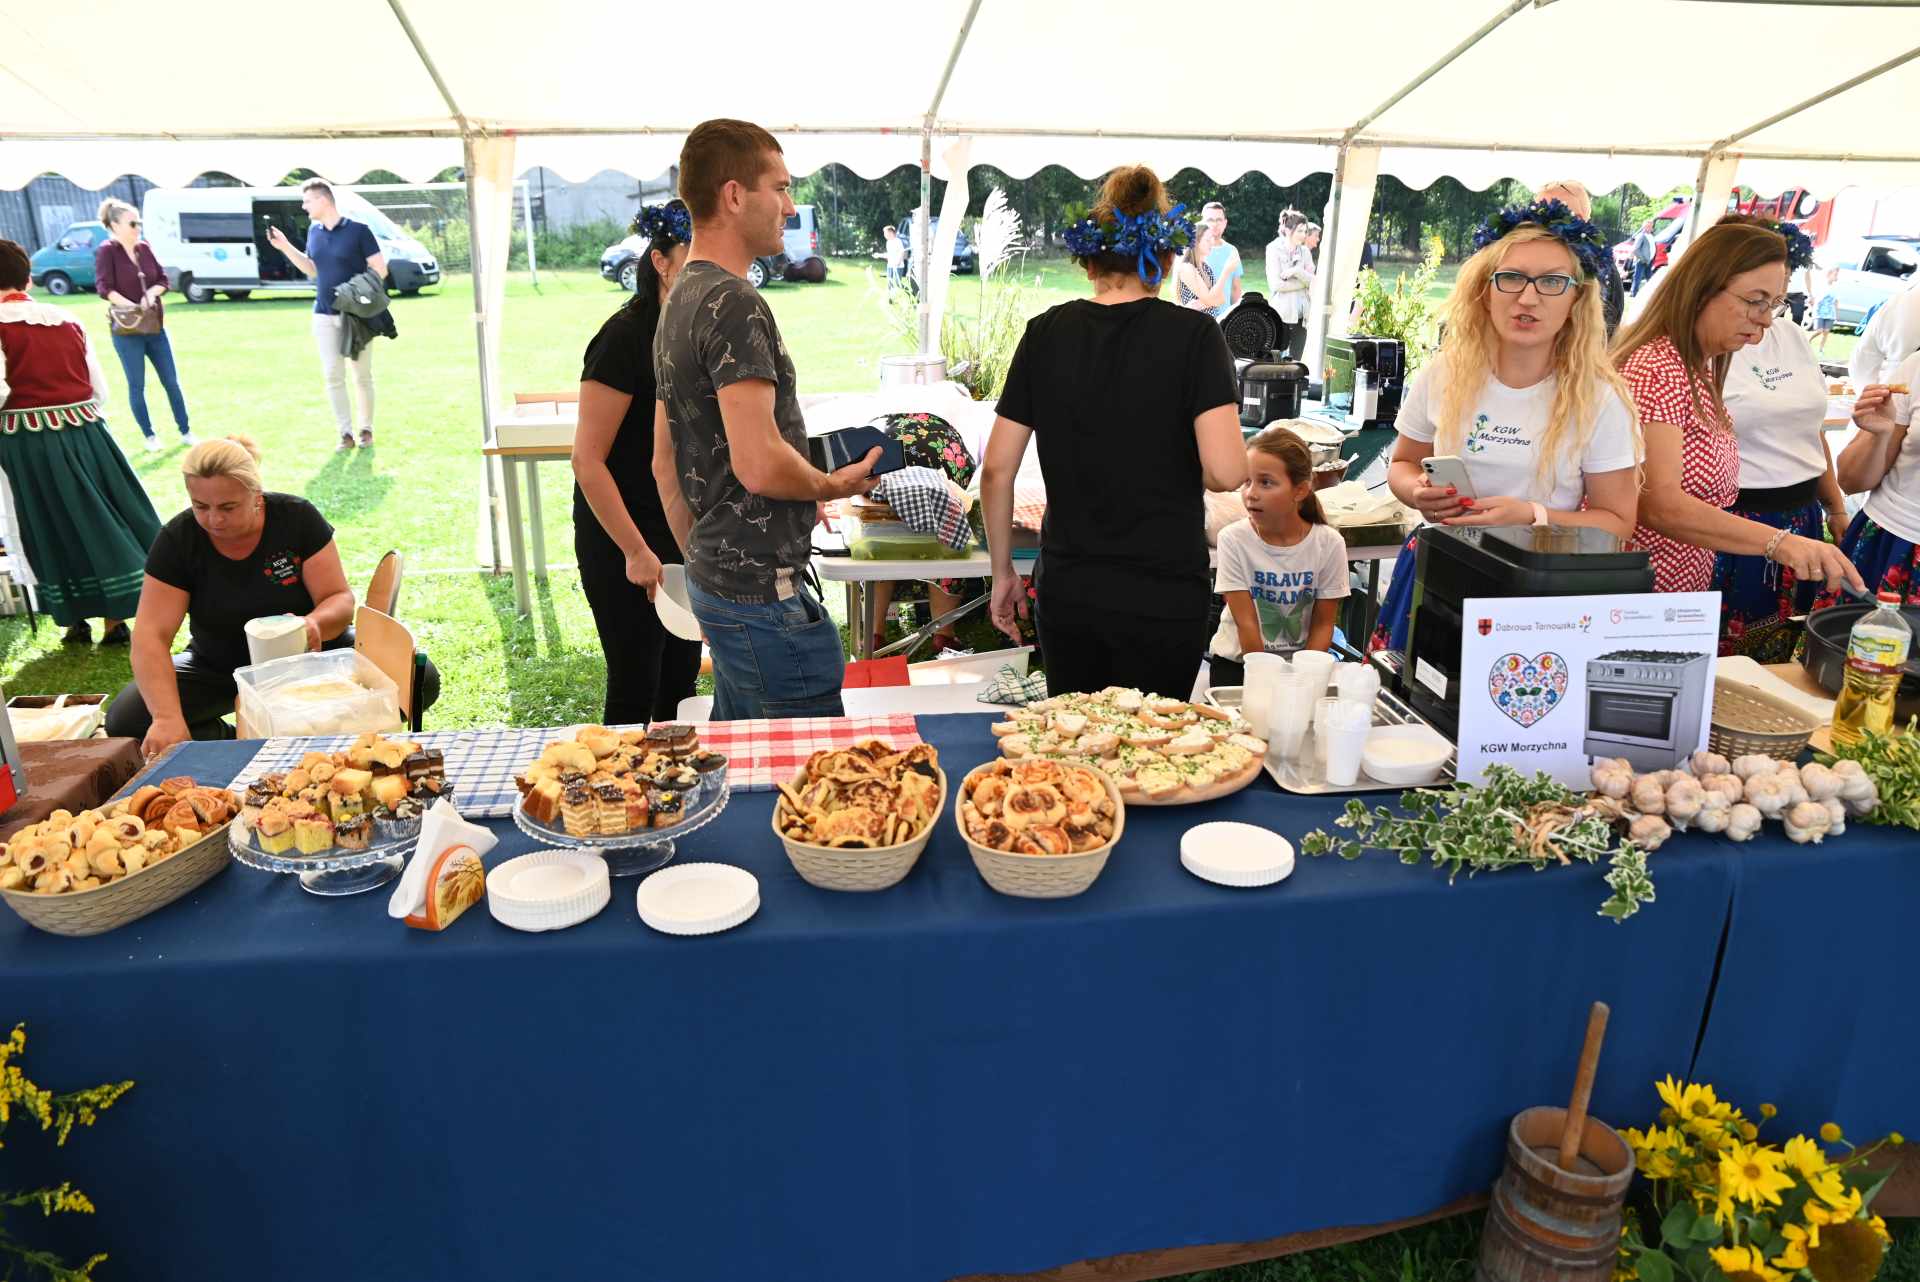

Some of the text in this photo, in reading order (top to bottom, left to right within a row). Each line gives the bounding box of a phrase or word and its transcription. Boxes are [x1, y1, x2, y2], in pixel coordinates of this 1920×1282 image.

[1492, 425, 1522, 435] KGW
[1478, 432, 1531, 446] Morzychna
[1254, 570, 1313, 587] BRAVE
[1480, 741, 1568, 754] KGW Morzychna
